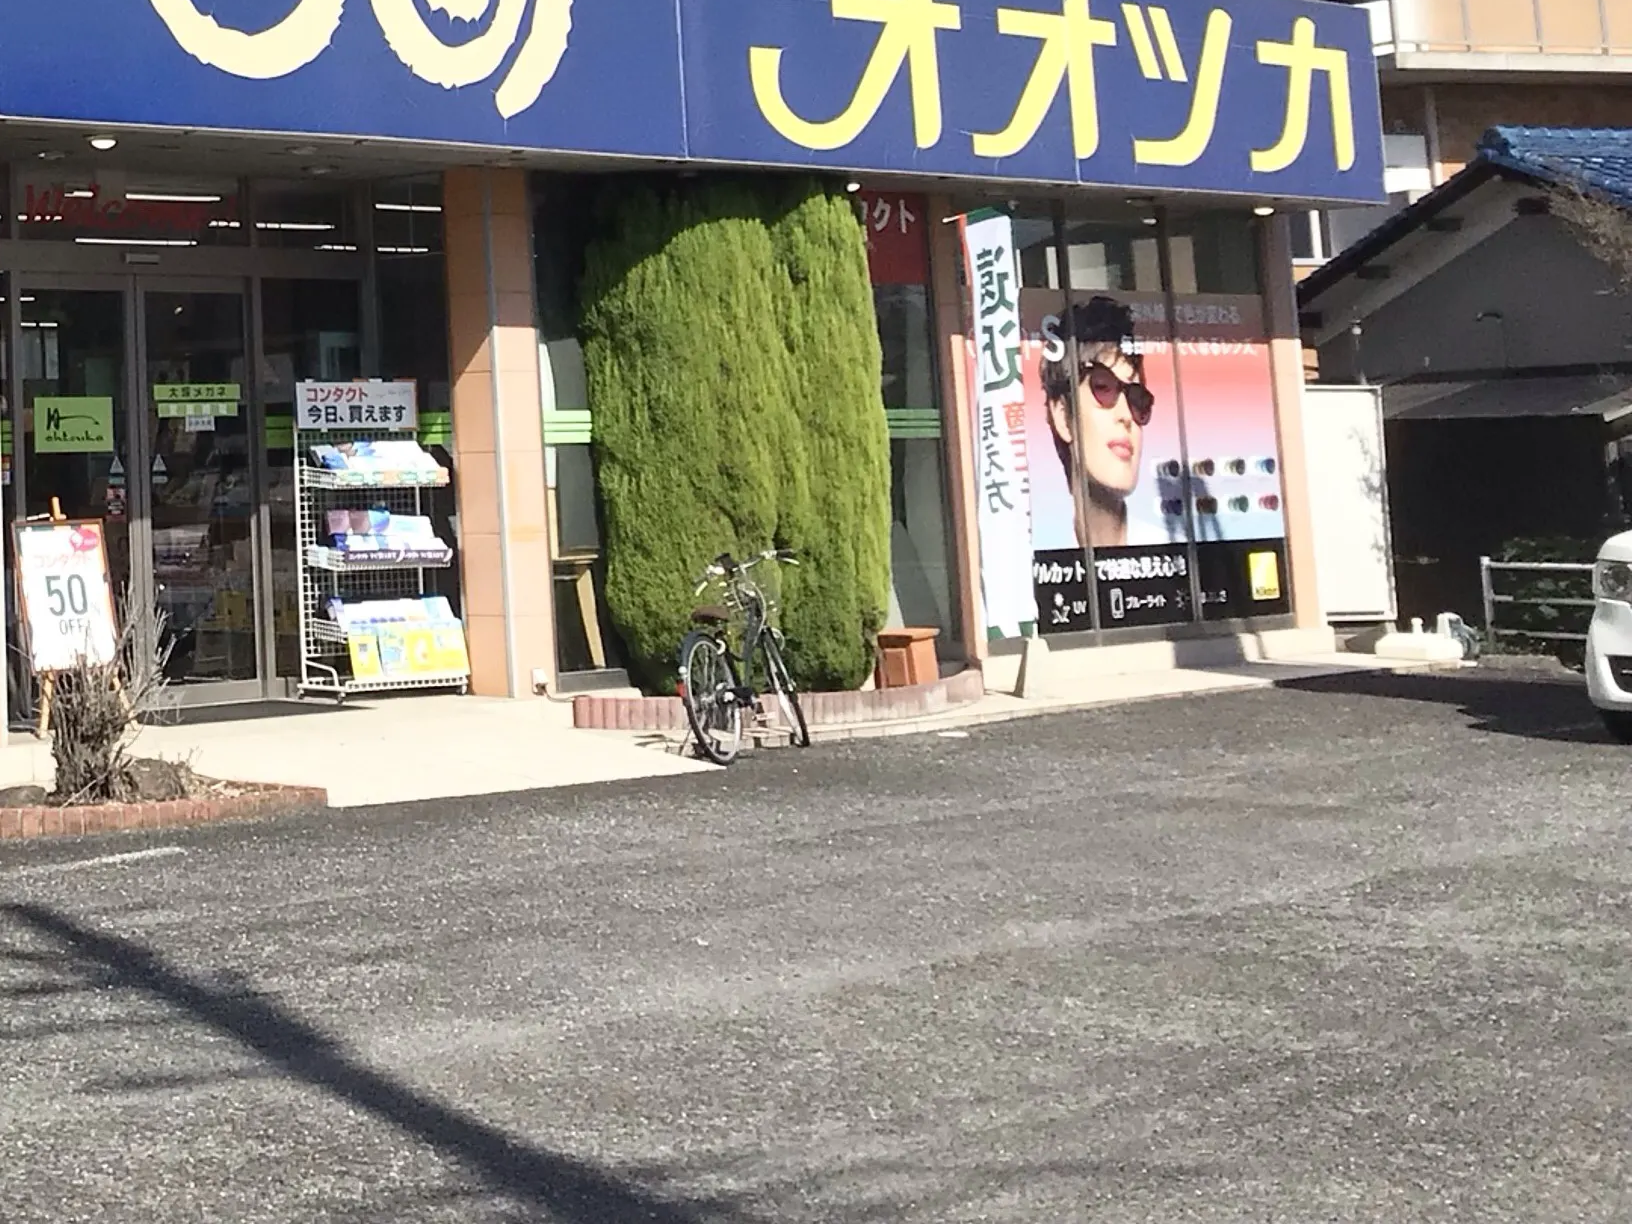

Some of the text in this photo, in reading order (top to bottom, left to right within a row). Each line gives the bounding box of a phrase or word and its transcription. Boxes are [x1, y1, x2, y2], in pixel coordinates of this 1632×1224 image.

[306, 387, 369, 403] コンタクト
[306, 404, 407, 424] 今日、買えます
